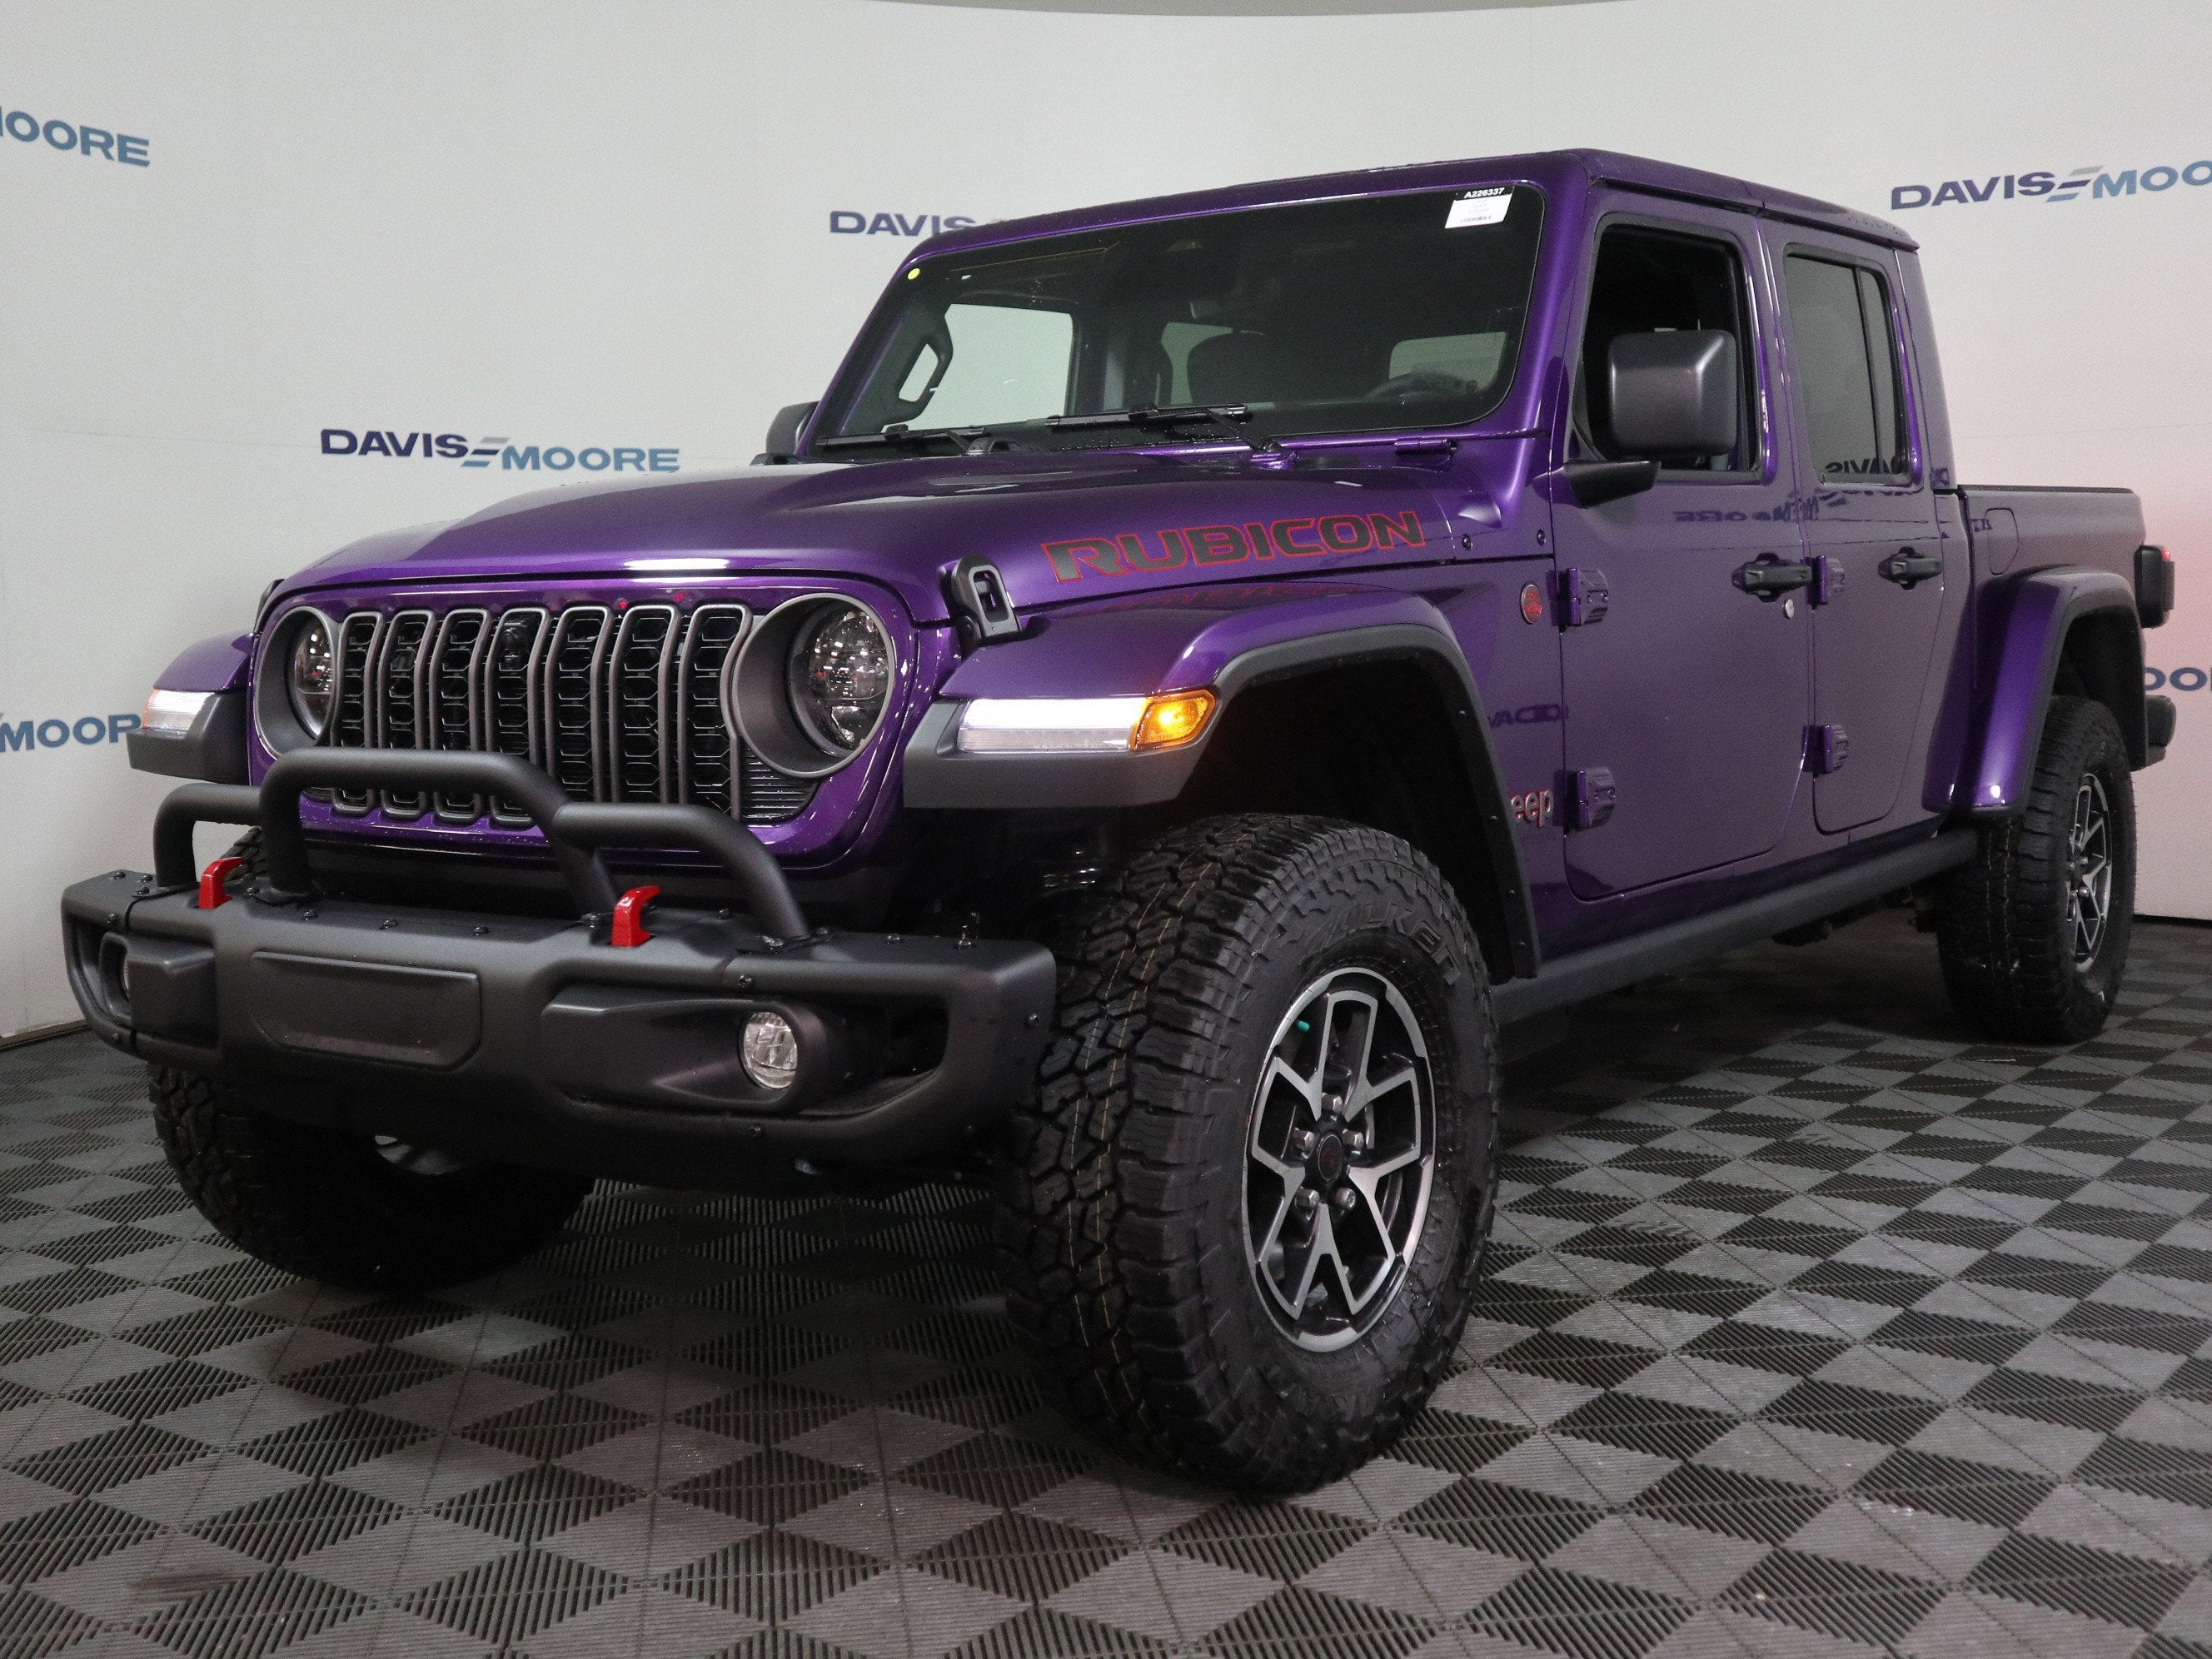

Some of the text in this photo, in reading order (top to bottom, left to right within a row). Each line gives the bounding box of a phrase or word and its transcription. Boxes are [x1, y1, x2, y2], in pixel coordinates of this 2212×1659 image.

[0, 107, 150, 167] OORE
[1463, 187, 1505, 199] A226337
[1891, 172, 2055, 209] DAVIS
[321, 429, 680, 472] DAVIS MOORE
[1043, 511, 1426, 582] RUBICON
[1509, 789, 1554, 829] eep
